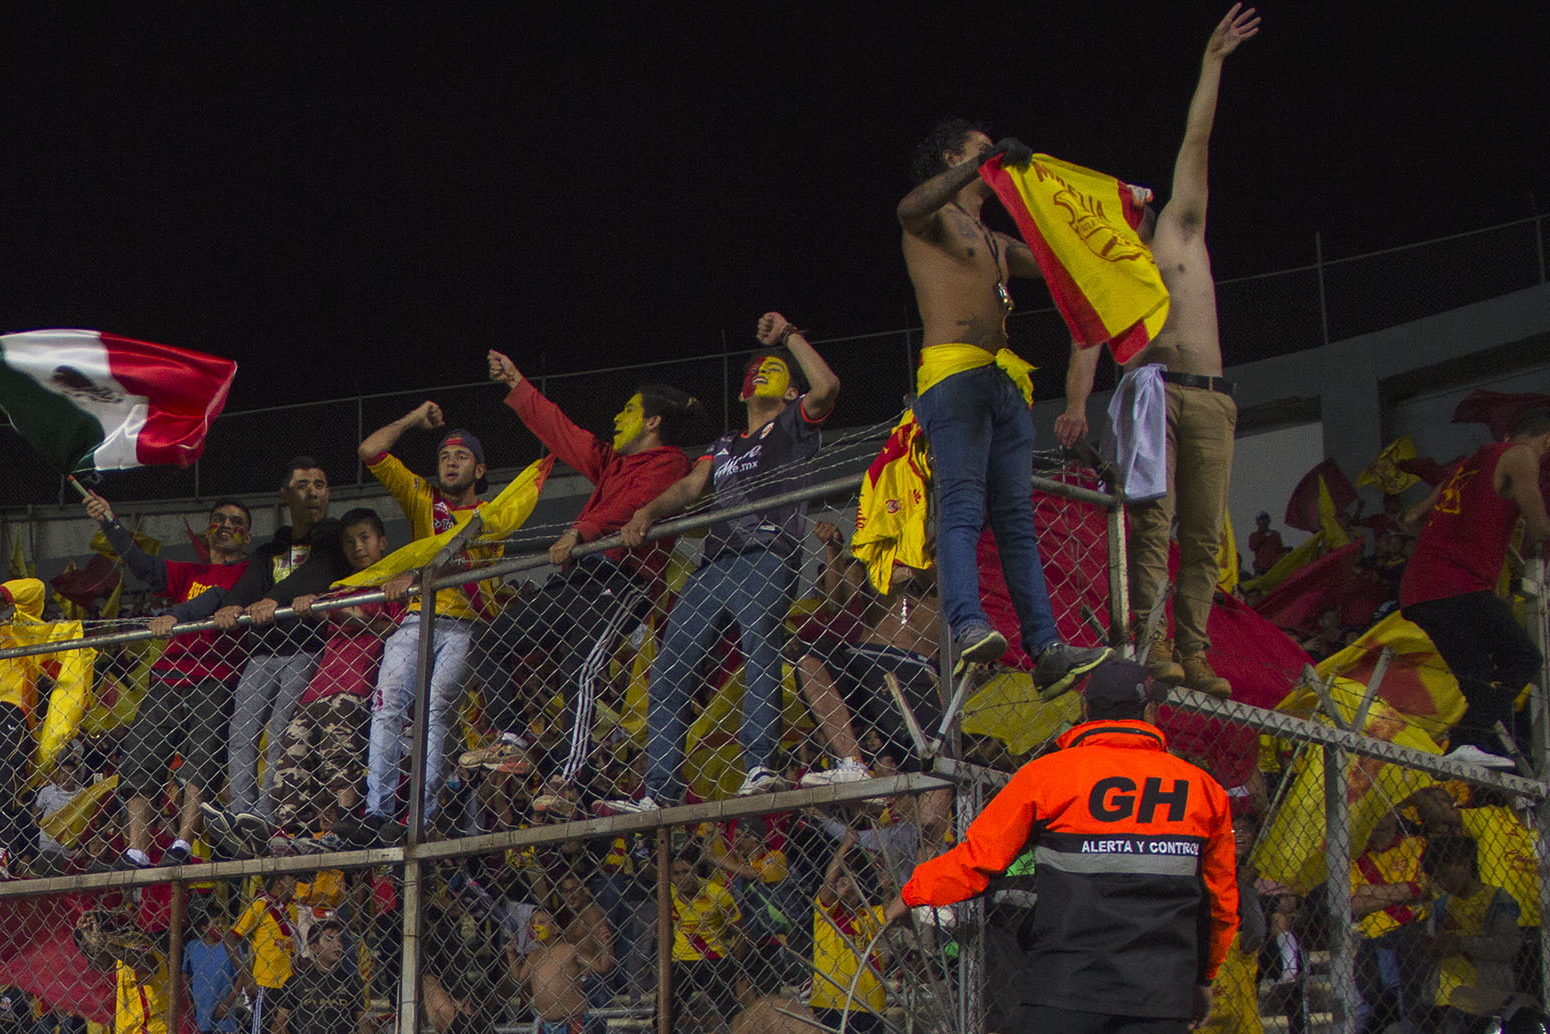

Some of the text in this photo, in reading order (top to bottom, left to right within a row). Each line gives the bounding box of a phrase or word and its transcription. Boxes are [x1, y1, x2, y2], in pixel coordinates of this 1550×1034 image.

[1088, 776, 1190, 824] GH
[1081, 840, 1199, 856] ALERTA Y CONTROL
